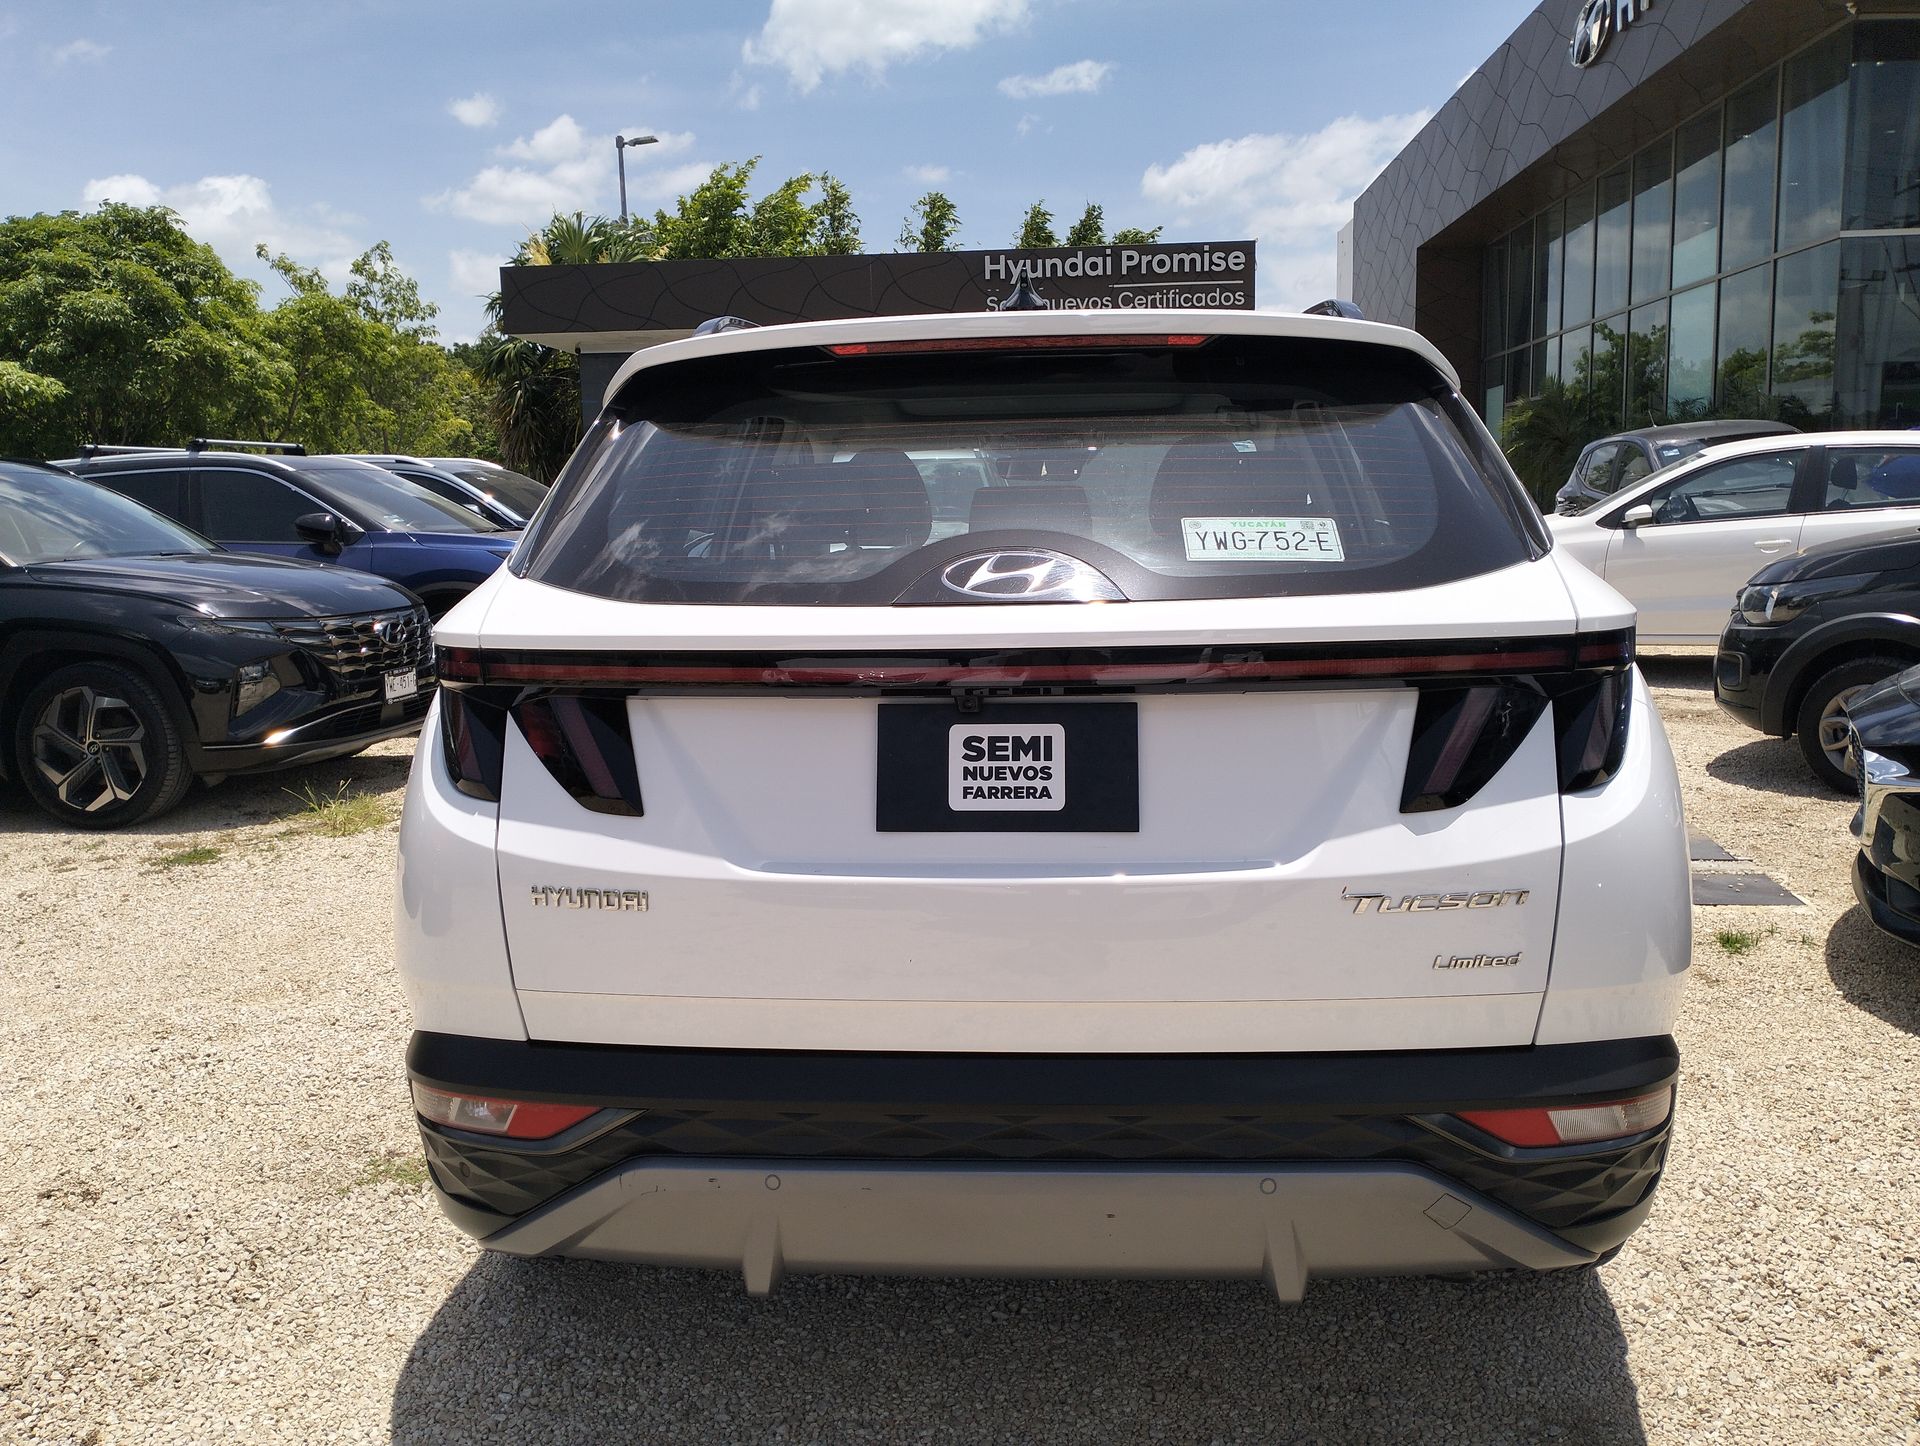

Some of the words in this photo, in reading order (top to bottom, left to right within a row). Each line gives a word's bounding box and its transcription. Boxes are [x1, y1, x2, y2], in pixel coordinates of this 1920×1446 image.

[984, 248, 1112, 285] Hyundai
[1121, 245, 1246, 276] Promise
[1118, 287, 1245, 309] Certificados
[1195, 531, 1334, 552] YWG-752-E
[961, 735, 1053, 762] SEMI
[962, 766, 1053, 781] NUEVOS
[962, 785, 1053, 799] FARRERA
[531, 885, 649, 912] HYUNDAI
[1432, 951, 1523, 970] Limited
